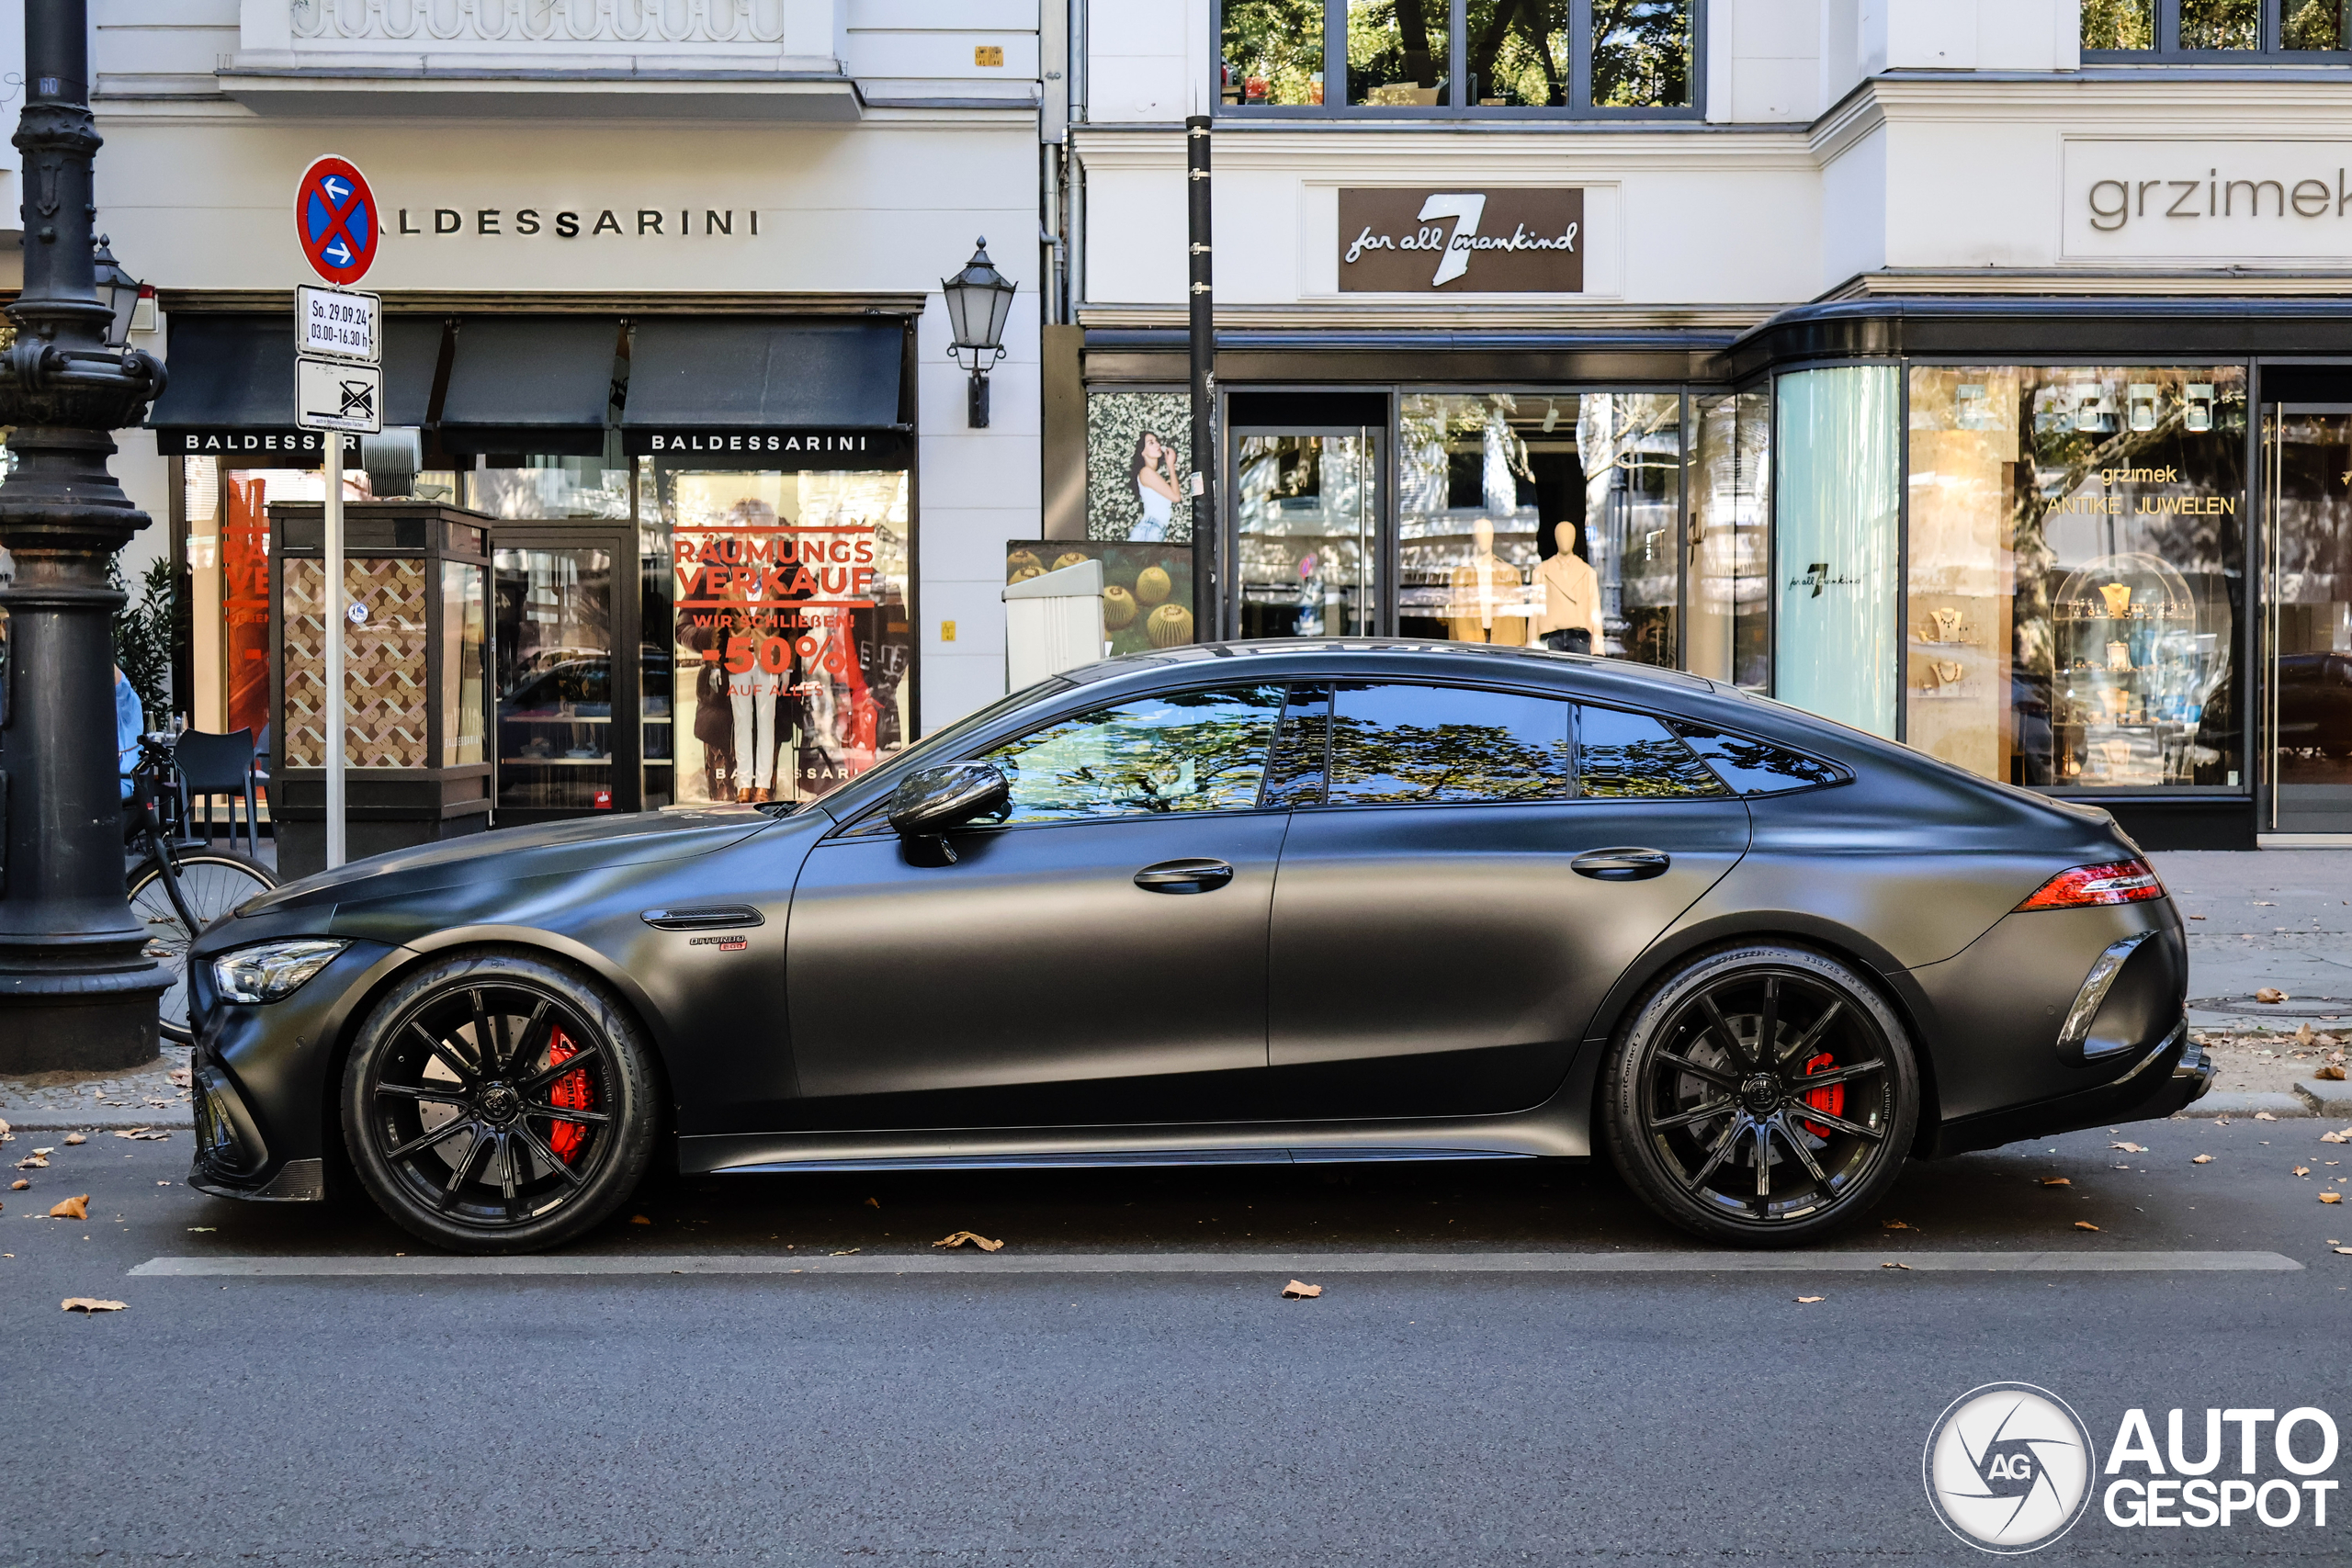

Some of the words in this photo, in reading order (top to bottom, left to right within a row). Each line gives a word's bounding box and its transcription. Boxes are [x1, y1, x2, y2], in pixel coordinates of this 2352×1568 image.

[40, 77, 58, 94] 60
[379, 209, 759, 237] LDESSARINI
[1344, 226, 1396, 264] for
[1399, 226, 1442, 251] all
[1417, 193, 1487, 287] 7
[1452, 221, 1578, 253] mankind
[312, 300, 326, 319] So.
[329, 304, 368, 326] 29.09.24
[311, 323, 360, 346] 03.00-16.30
[362, 333, 368, 347] h
[651, 435, 865, 450] BALDESSARINI
[2100, 464, 2177, 486] grzimek
[2045, 497, 2121, 514] ANTIKE
[2134, 497, 2235, 514] JUWELEN
[674, 534, 873, 563] RÄUMUNGS
[675, 567, 873, 594] VERKAUF
[693, 615, 732, 628] WIR
[702, 636, 846, 675] -50%
[727, 684, 763, 696] AUF
[769, 684, 824, 696] ALLES
[1804, 955, 1840, 975] 335/25
